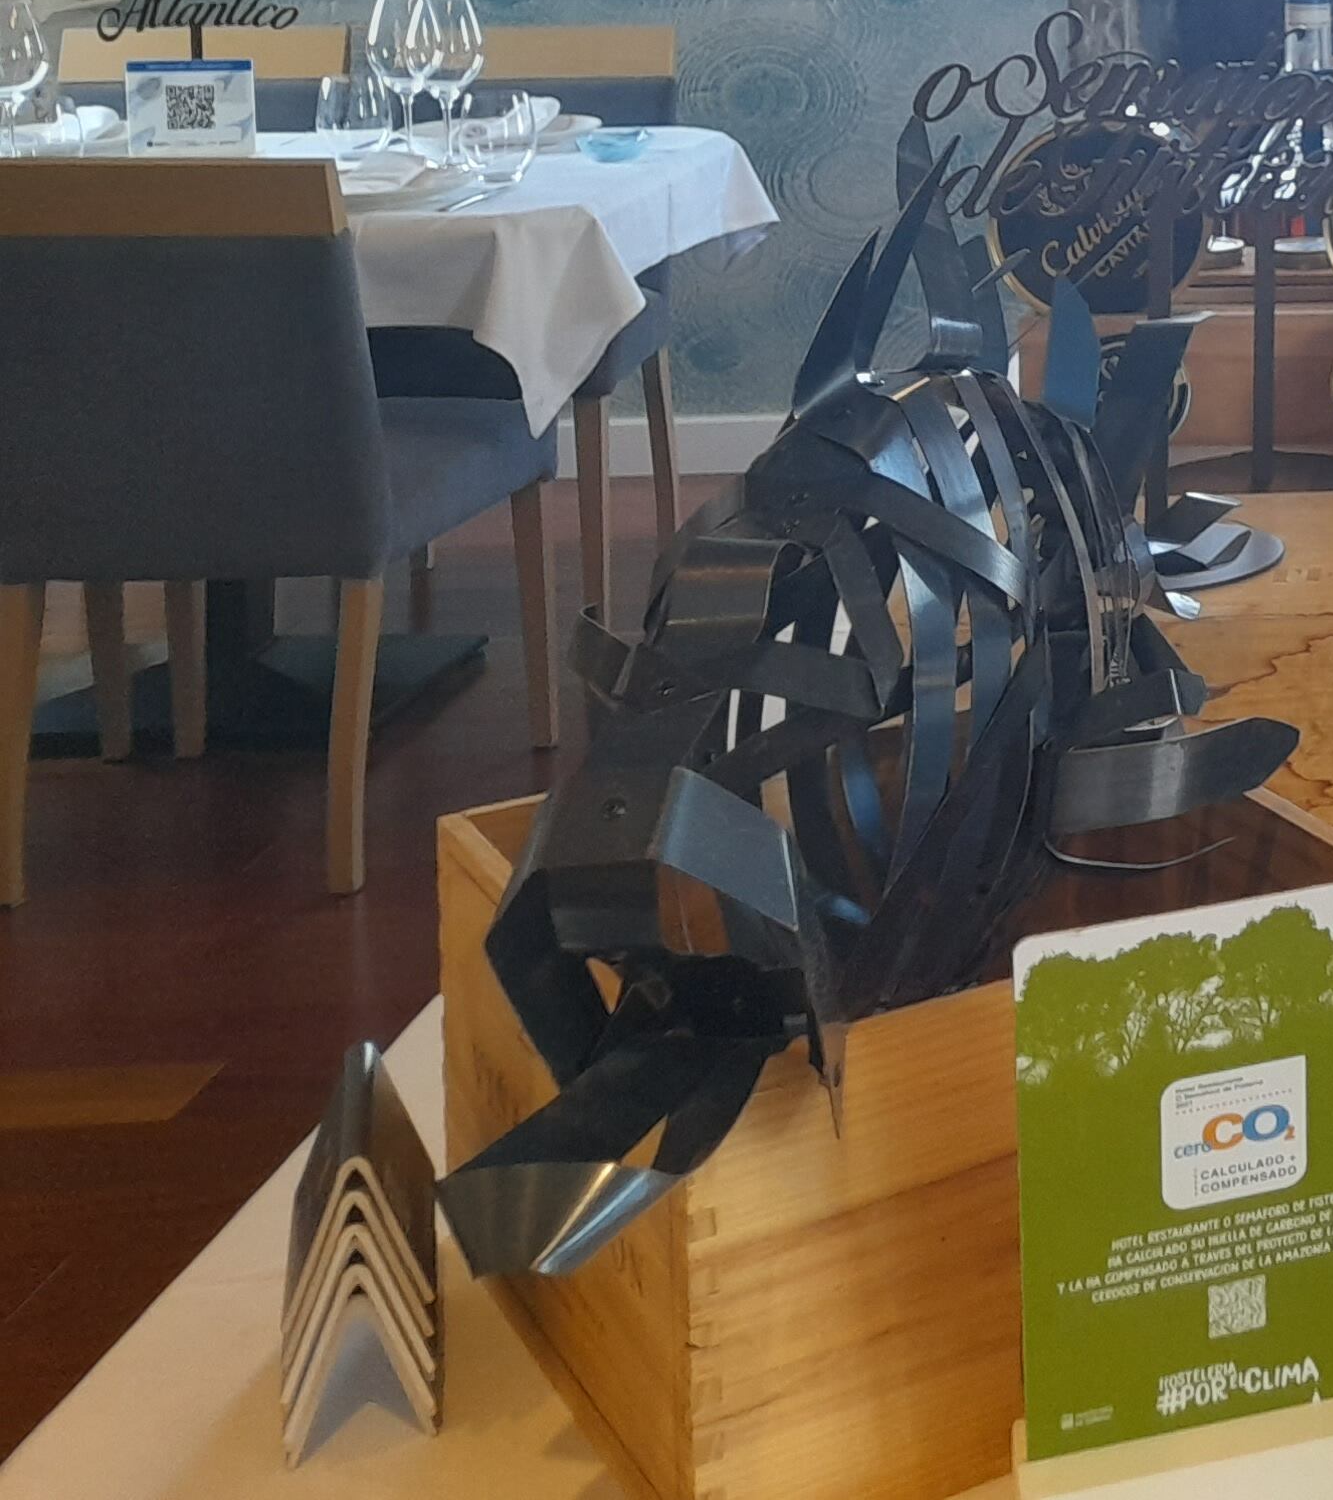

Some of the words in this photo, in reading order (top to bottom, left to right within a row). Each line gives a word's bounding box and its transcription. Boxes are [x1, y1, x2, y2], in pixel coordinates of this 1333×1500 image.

[1200, 1165, 1298, 1194] COMPENSADO
[1201, 1154, 1285, 1181] CALCULADO
[1108, 1256, 1123, 1268] HA
[1126, 1242, 1187, 1264] CALCULADO
[1191, 1238, 1205, 1250] SU
[1250, 1225, 1262, 1238] DE
[1266, 1214, 1316, 1234] CARBONO
[1319, 1210, 1332, 1222] DE
[1111, 1235, 1144, 1251] HOTEL
[1293, 1200, 1306, 1212] DE
[1057, 1283, 1066, 1295] Y
[1069, 1278, 1083, 1293] LA
[1086, 1275, 1100, 1289] HA
[1104, 1259, 1178, 1285] COMPENSADO
[1182, 1257, 1190, 1268] A
[1235, 1243, 1252, 1258] DEL
[1256, 1232, 1308, 1252] PROYECTO
[1310, 1228, 1323, 1241] DE
[1143, 1280, 1157, 1292] DE
[1242, 1259, 1255, 1271] DE
[1259, 1255, 1272, 1267] LA
